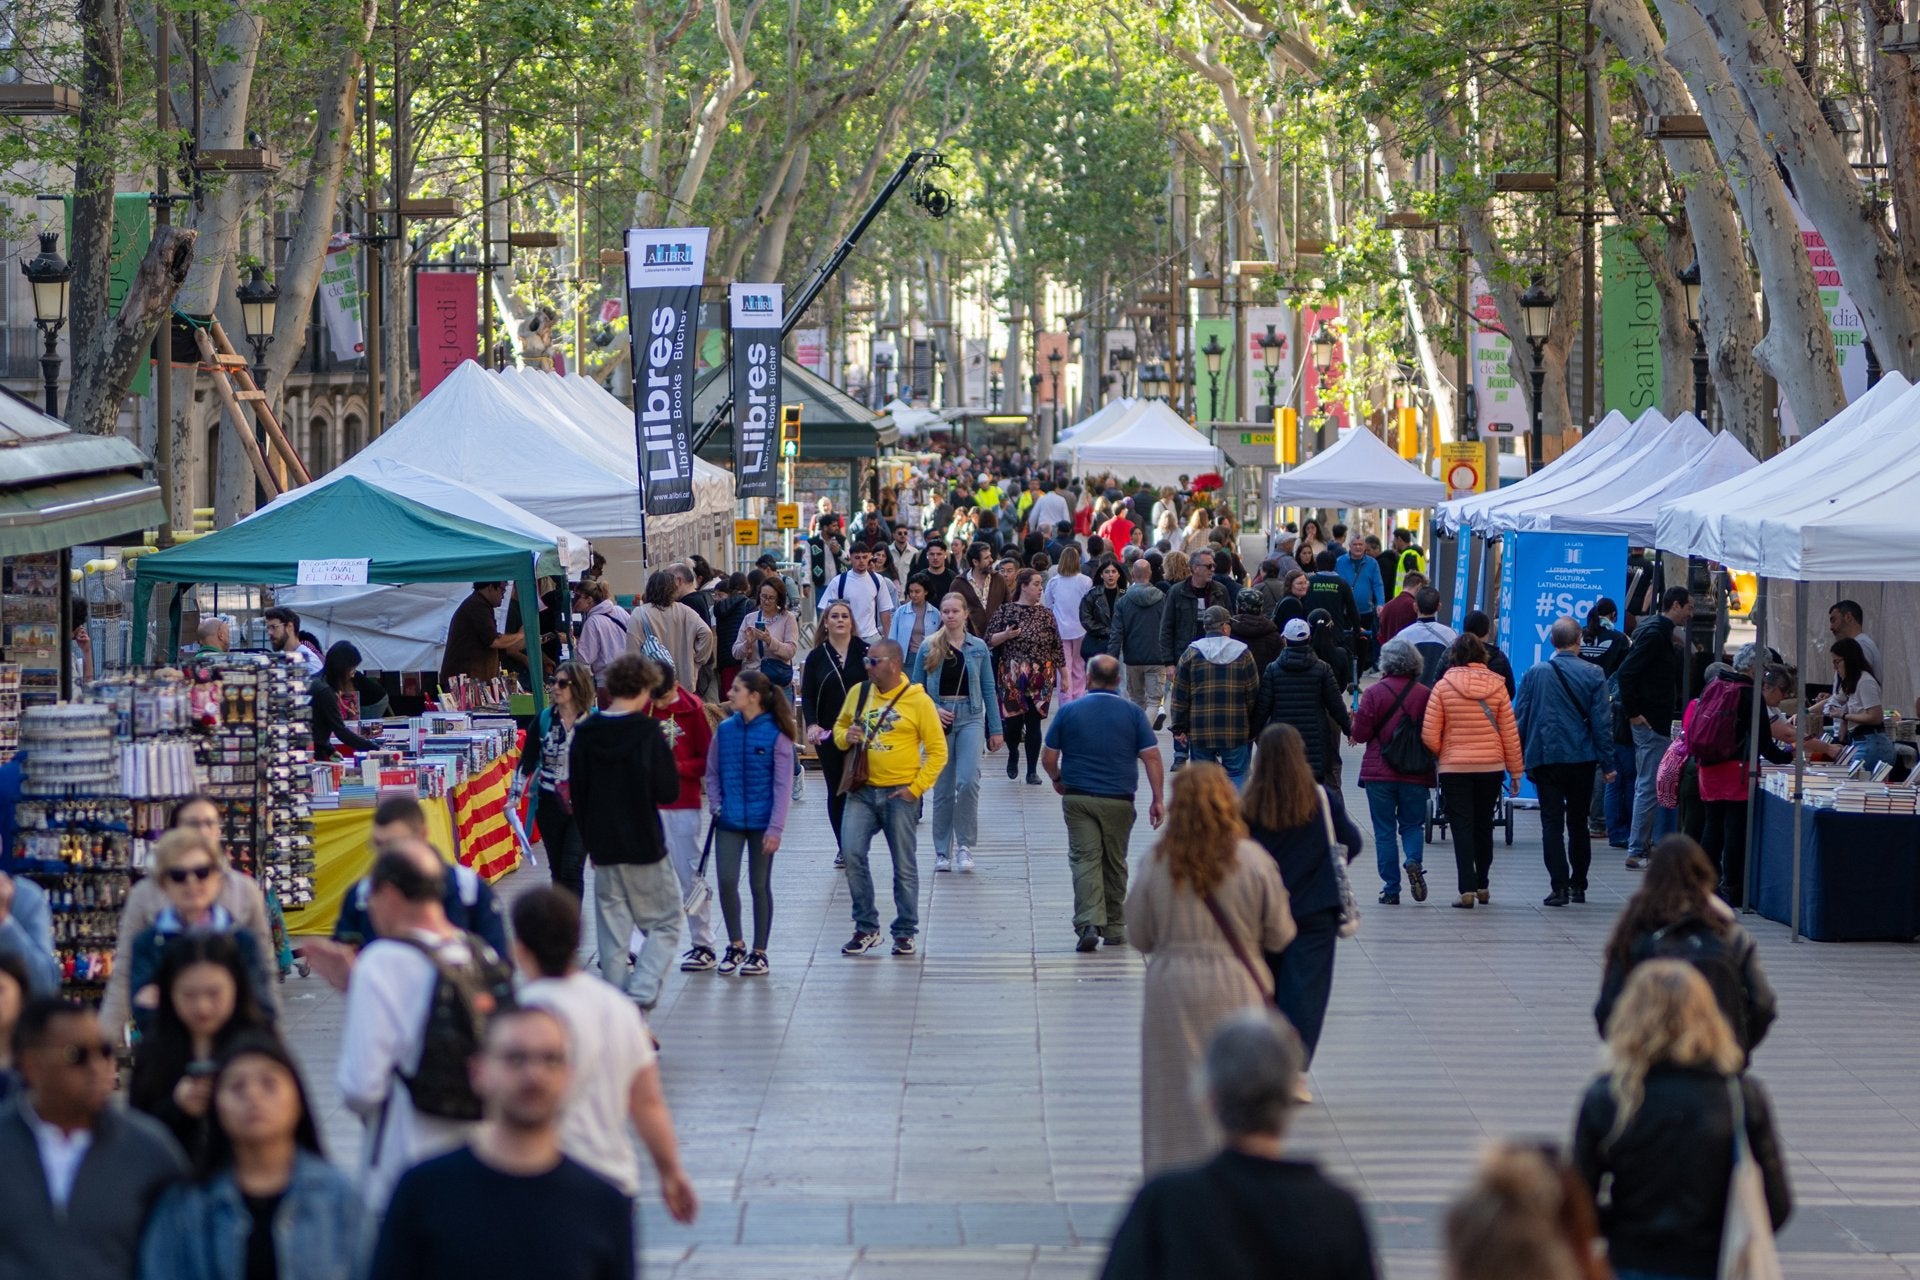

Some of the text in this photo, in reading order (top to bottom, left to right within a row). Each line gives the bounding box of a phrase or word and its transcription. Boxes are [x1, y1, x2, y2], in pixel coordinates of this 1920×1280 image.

[648, 251, 691, 264] ALIBRI
[328, 284, 345, 298] de
[1832, 308, 1858, 327] dia
[437, 299, 463, 357] Jordi
[1627, 261, 1660, 408] Sant Jordi
[1832, 331, 1857, 346] ant
[1480, 349, 1505, 361] Bon
[1480, 362, 1511, 375] de Sa
[643, 307, 679, 481] Llibres
[673, 309, 690, 477] Libros Books Bücher
[743, 342, 767, 474] Llibres
[761, 345, 777, 472] Libros Books Bücher
[1255, 433, 1276, 443] ONC
[653, 490, 690, 501] www.alibri.cat
[325, 574, 358, 582] LOKAL
[1554, 574, 1586, 582] CULTURA
[1537, 581, 1603, 591] LATINOAMERICANA
[1535, 592, 1604, 619] #Sa
